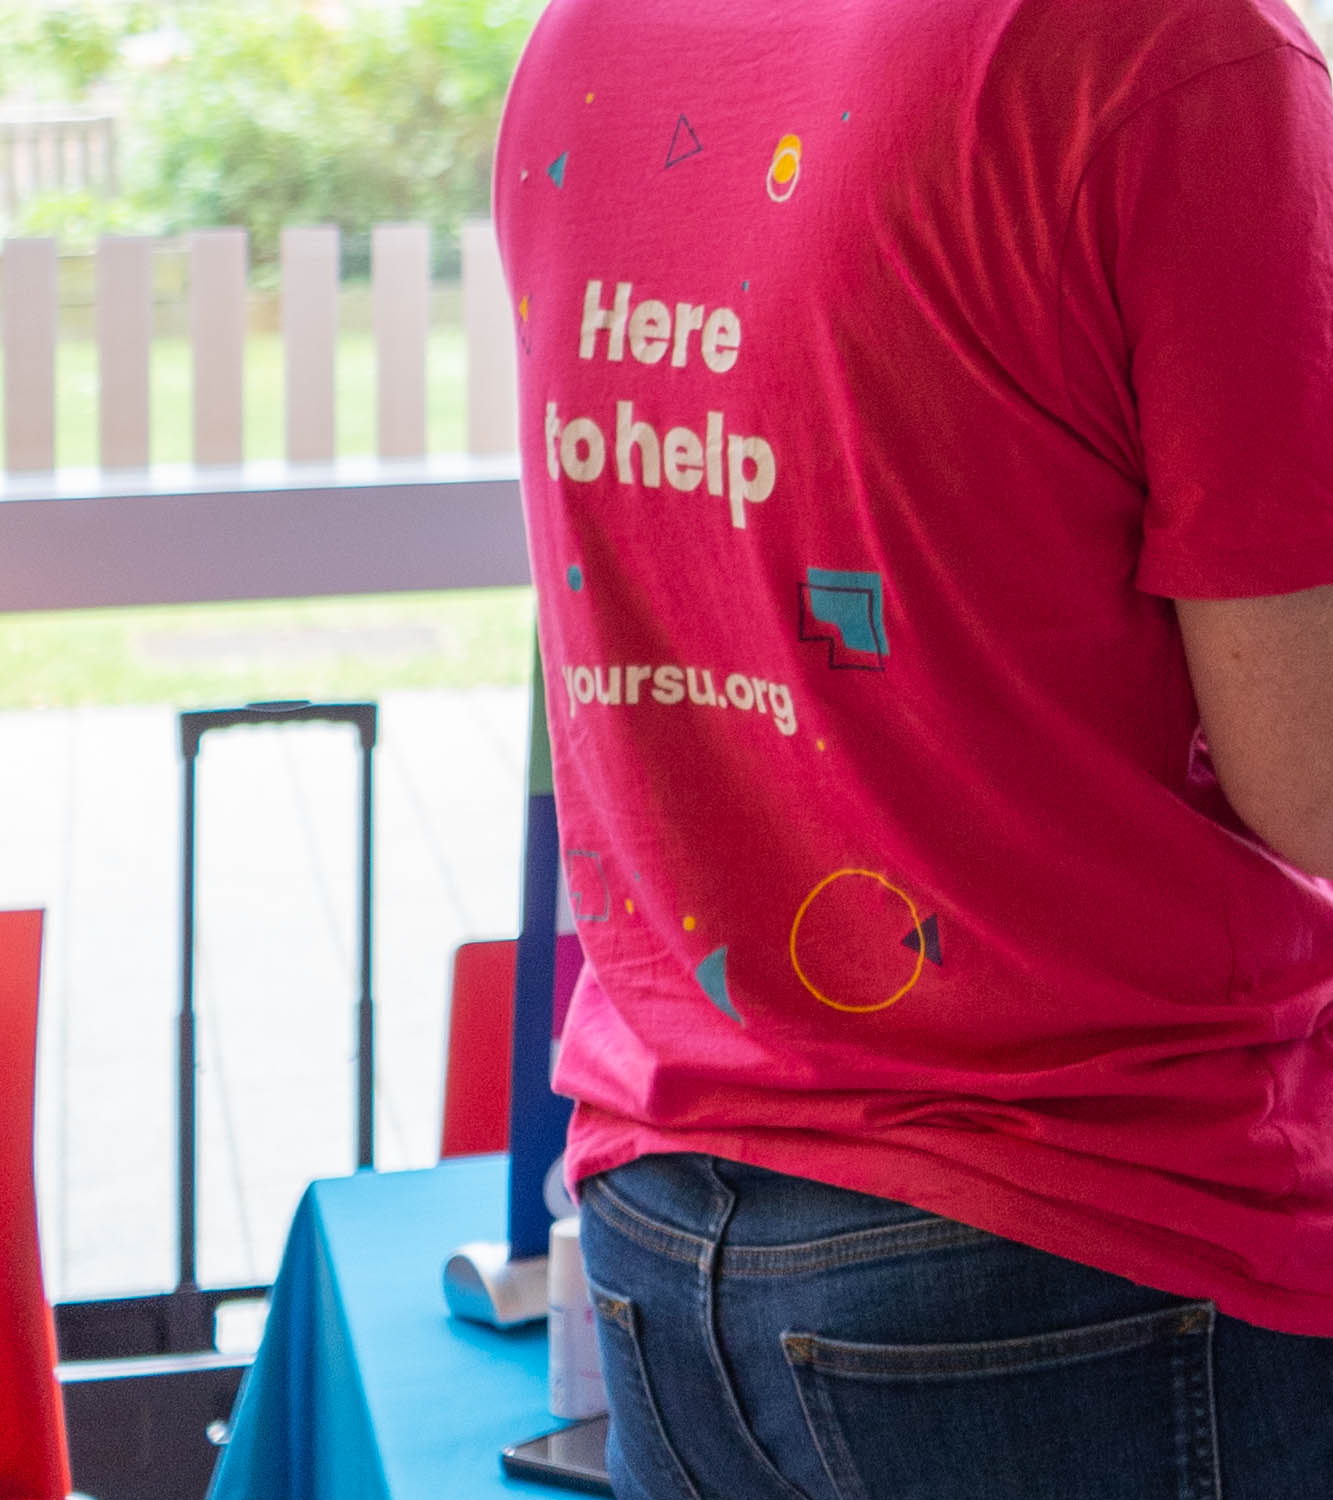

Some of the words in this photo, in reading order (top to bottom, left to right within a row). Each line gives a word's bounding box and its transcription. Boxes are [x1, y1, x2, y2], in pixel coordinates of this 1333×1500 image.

[579, 280, 742, 373] Here
[545, 400, 606, 483] to
[615, 400, 776, 530] help
[562, 665, 797, 736] yoursu.org
